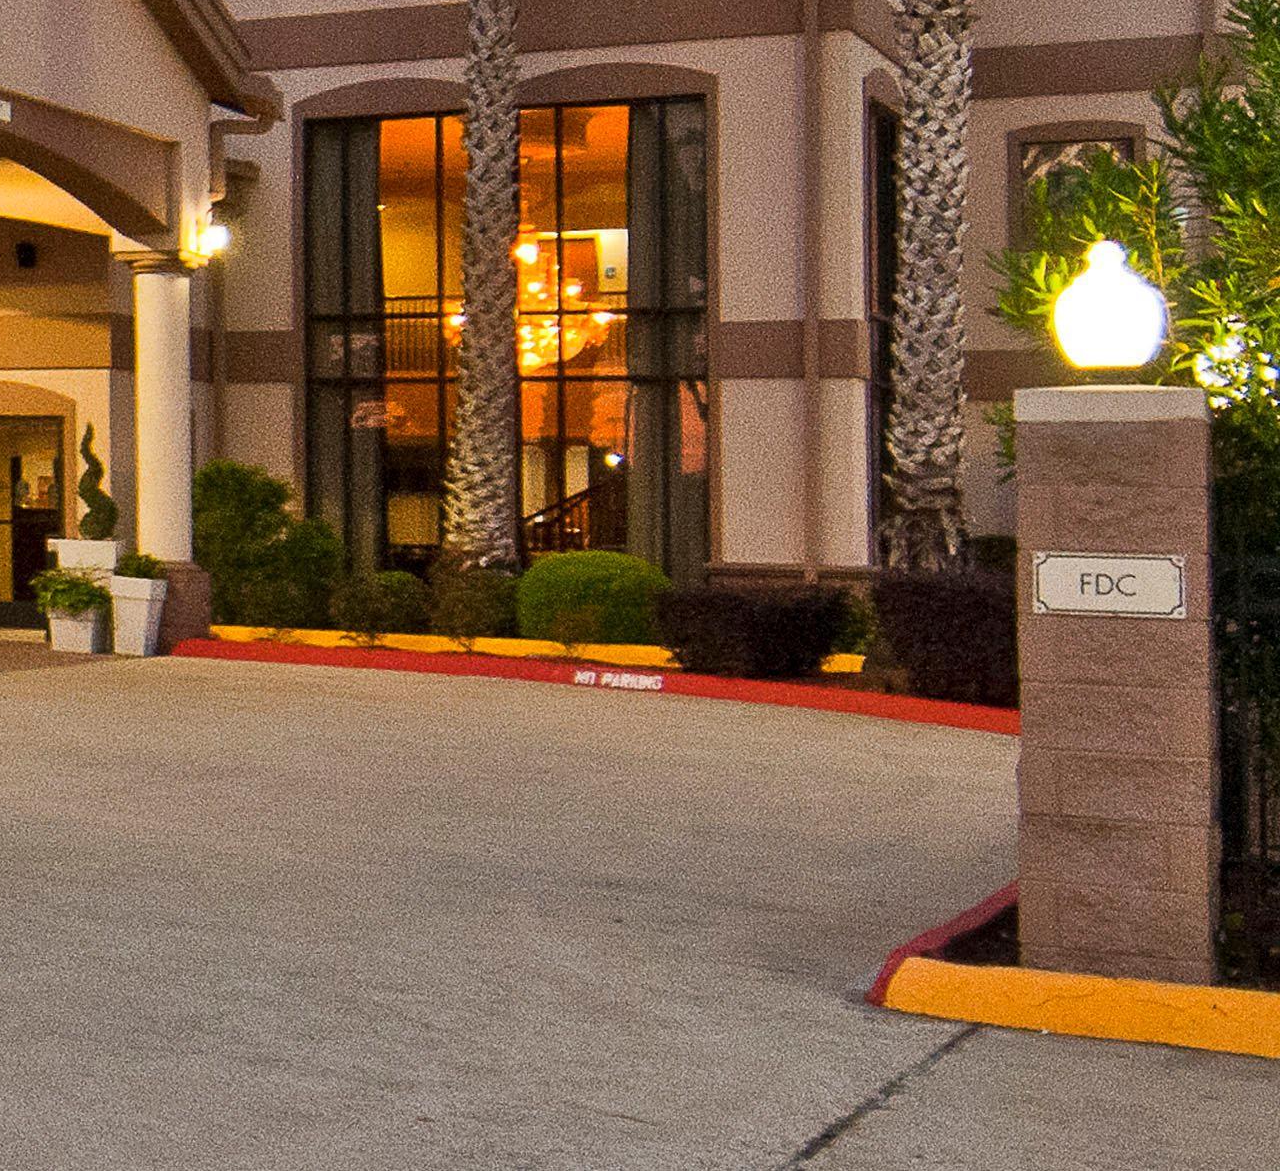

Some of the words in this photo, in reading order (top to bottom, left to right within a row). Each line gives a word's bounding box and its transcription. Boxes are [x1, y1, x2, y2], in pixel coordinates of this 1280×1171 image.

[1080, 573, 1137, 597] FDC
[574, 670, 596, 685] NO
[601, 672, 663, 690] PARKING
